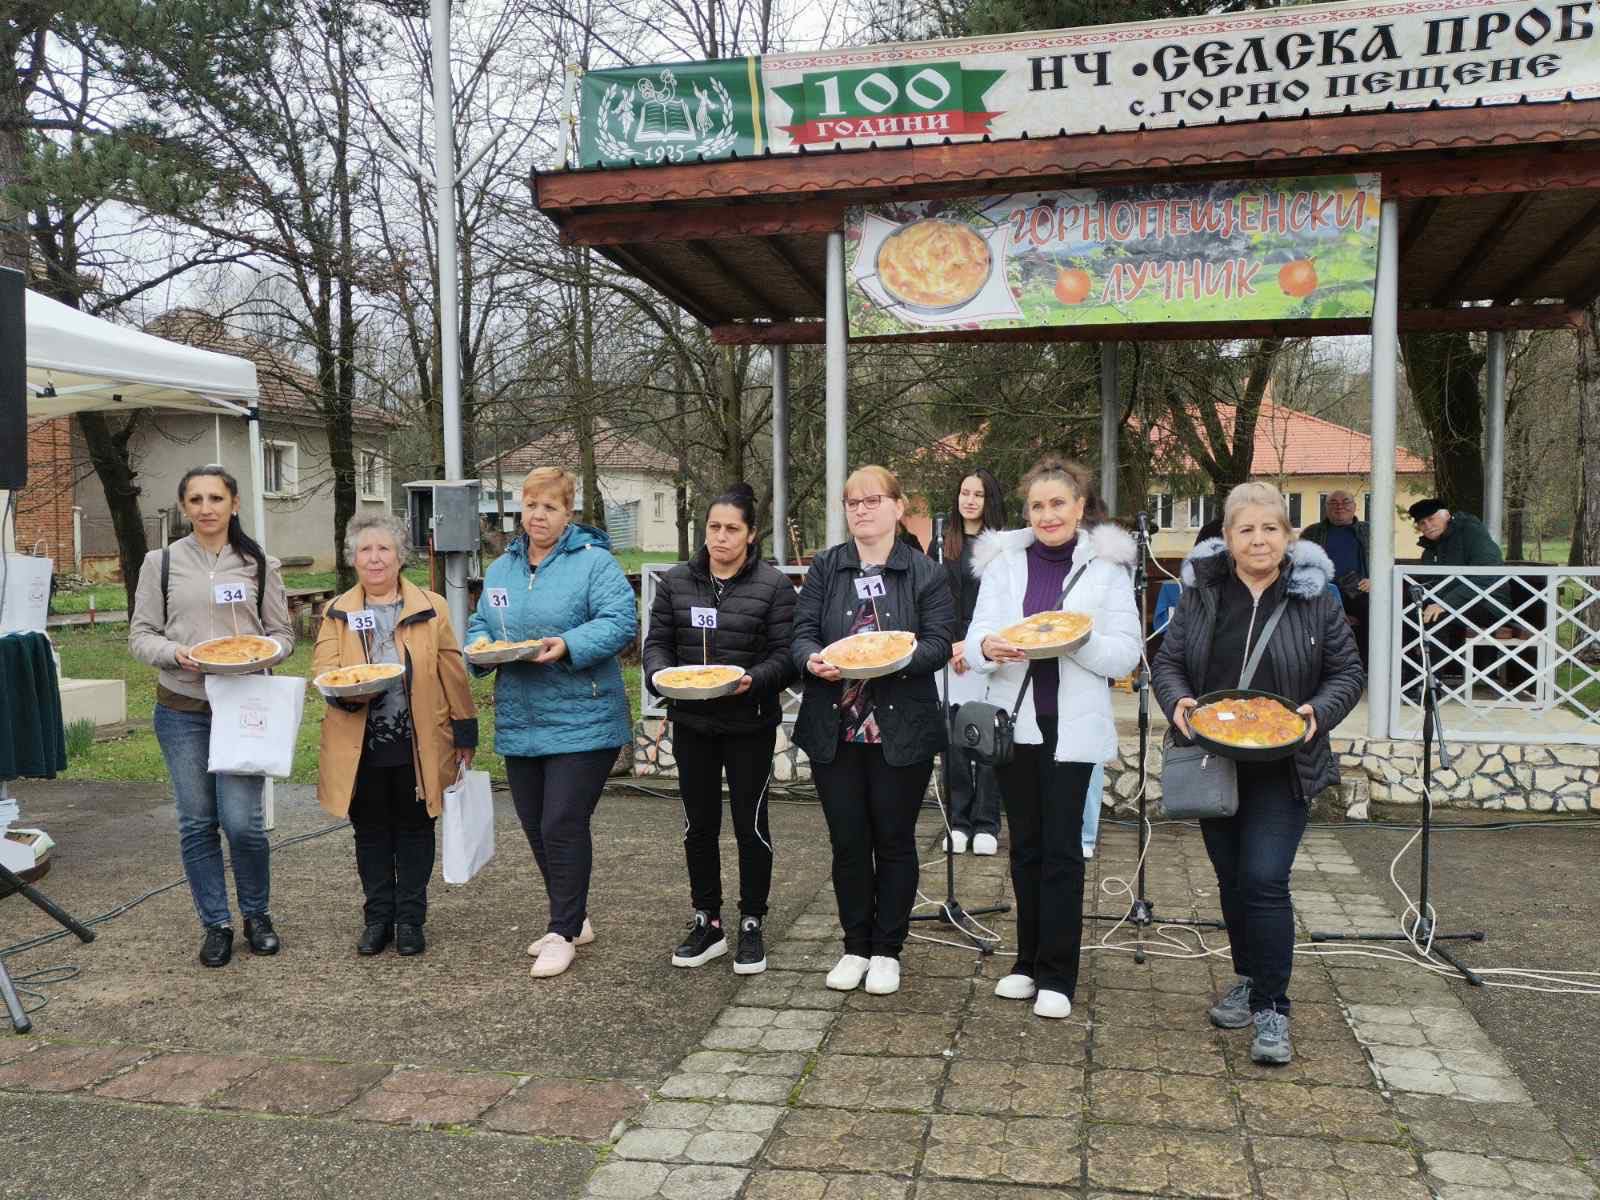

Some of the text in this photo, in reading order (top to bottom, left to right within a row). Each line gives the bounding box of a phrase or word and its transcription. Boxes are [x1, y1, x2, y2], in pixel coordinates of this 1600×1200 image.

[1028, 51, 1112, 92] НЧ
[1423, 1, 1600, 57] ПРОБ
[1326, 53, 1562, 98] ПЕЩЕНЕ
[815, 66, 953, 117] 100
[815, 113, 950, 138] ГОДИНИ
[1101, 258, 1265, 304] ЛУЧНИК
[223, 589, 243, 602] 34
[863, 582, 883, 597] 11
[492, 594, 508, 607] 31
[354, 616, 374, 629] 35
[697, 614, 714, 627] 36
